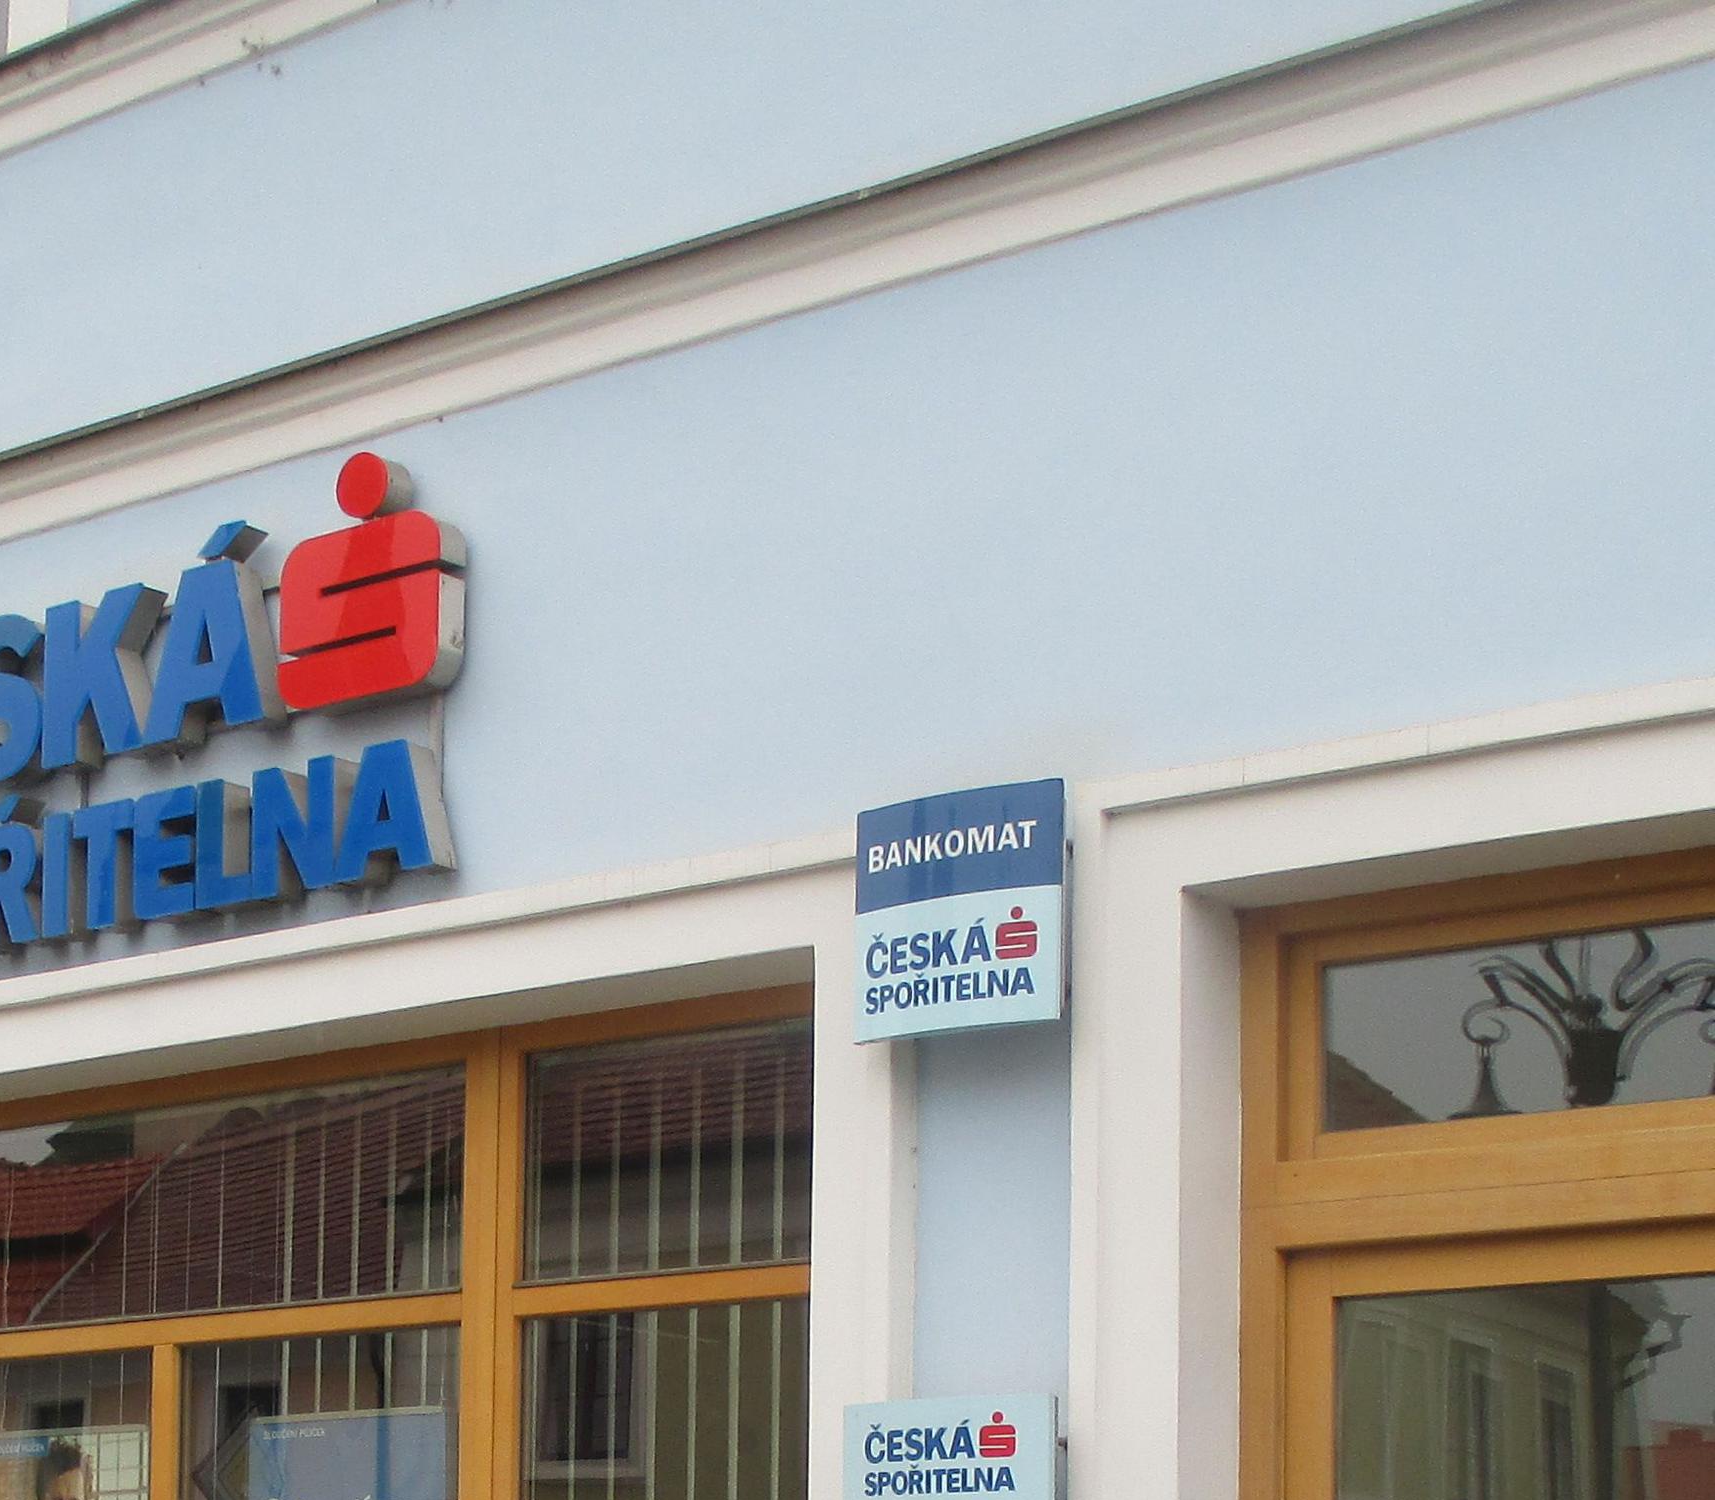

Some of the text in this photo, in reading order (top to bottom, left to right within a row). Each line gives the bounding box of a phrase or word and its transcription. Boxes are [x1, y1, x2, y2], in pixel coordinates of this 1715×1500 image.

[867, 820, 1038, 875] BANKOMAT
[865, 917, 992, 980] ČESKÁ
[864, 966, 1036, 1016] SPOŘITELNA
[864, 1419, 977, 1465] ČESKÁ
[863, 1463, 1017, 1497] SPOŘITELNA
